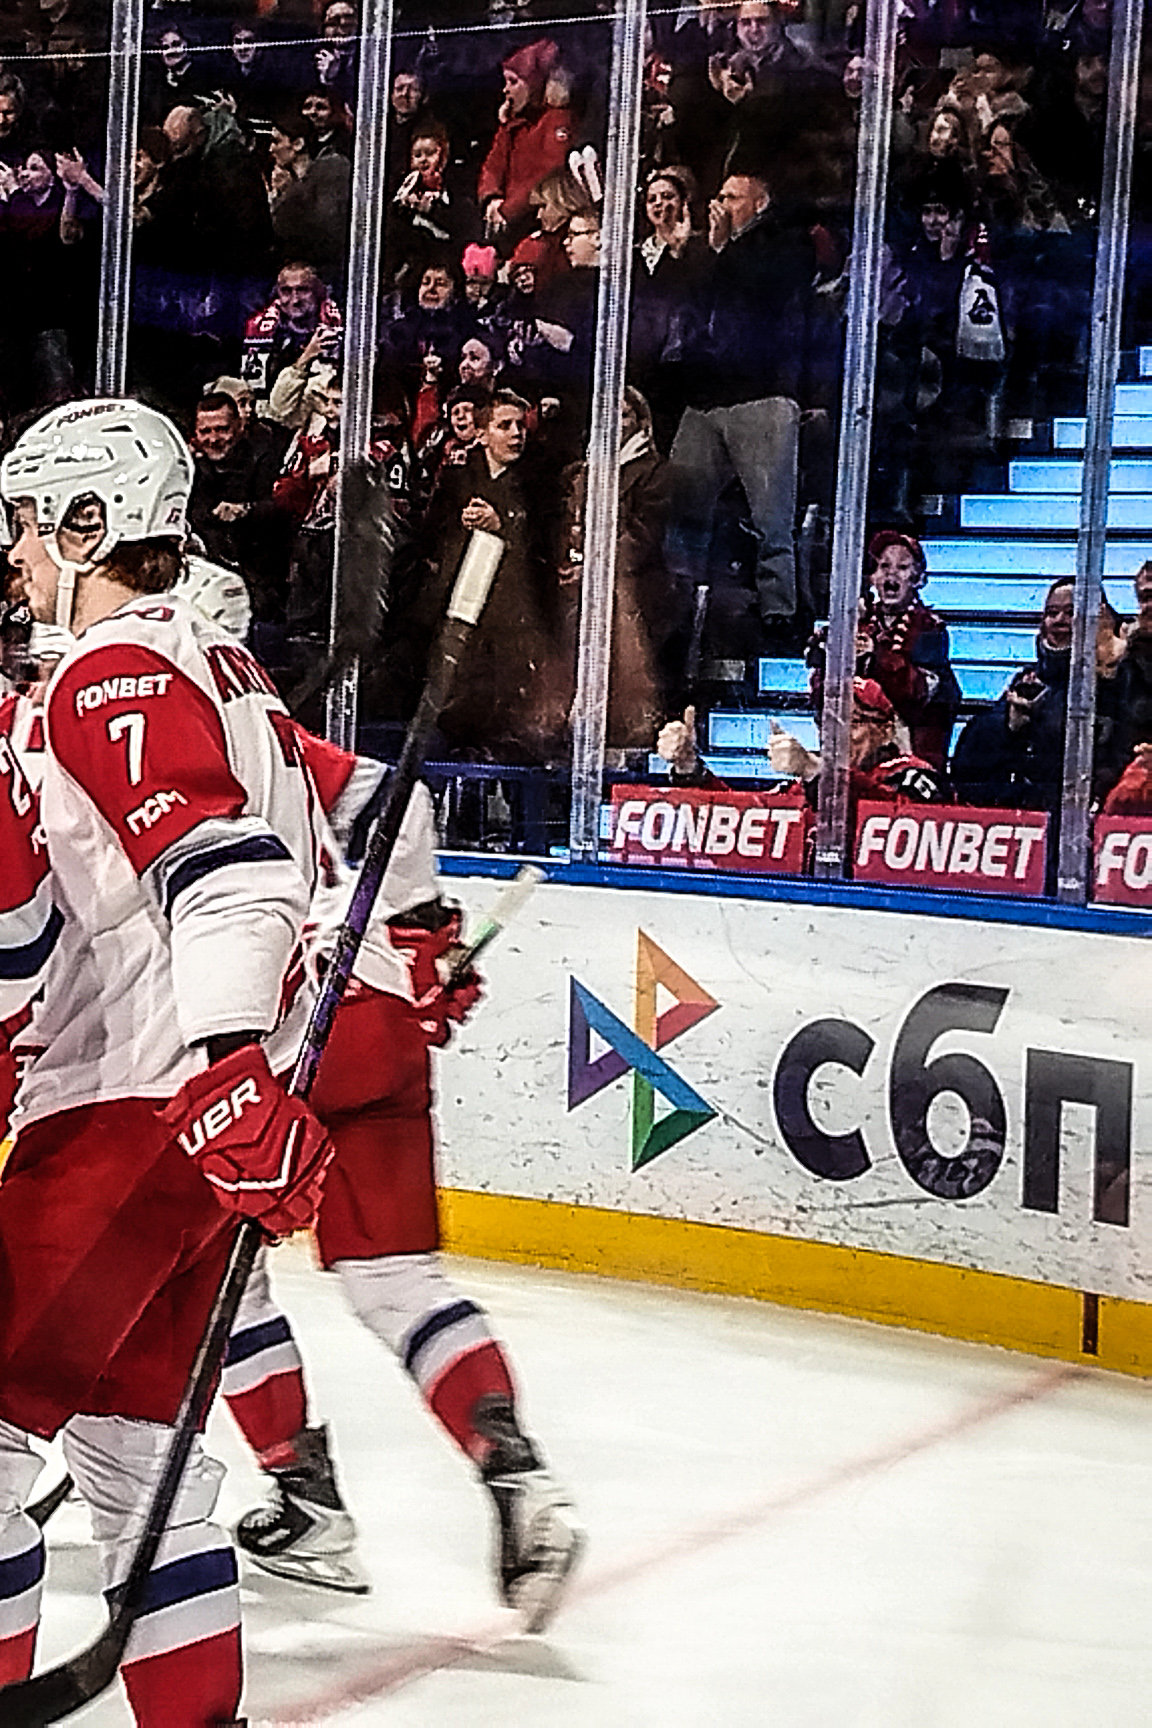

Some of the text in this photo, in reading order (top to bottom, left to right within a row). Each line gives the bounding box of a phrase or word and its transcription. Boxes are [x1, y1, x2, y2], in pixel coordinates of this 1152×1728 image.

[76, 673, 174, 718] FONBET
[108, 712, 146, 786] 7
[612, 799, 802, 861] FONBET
[856, 815, 1045, 880] FONBET
[772, 981, 1135, 1229] сбп
